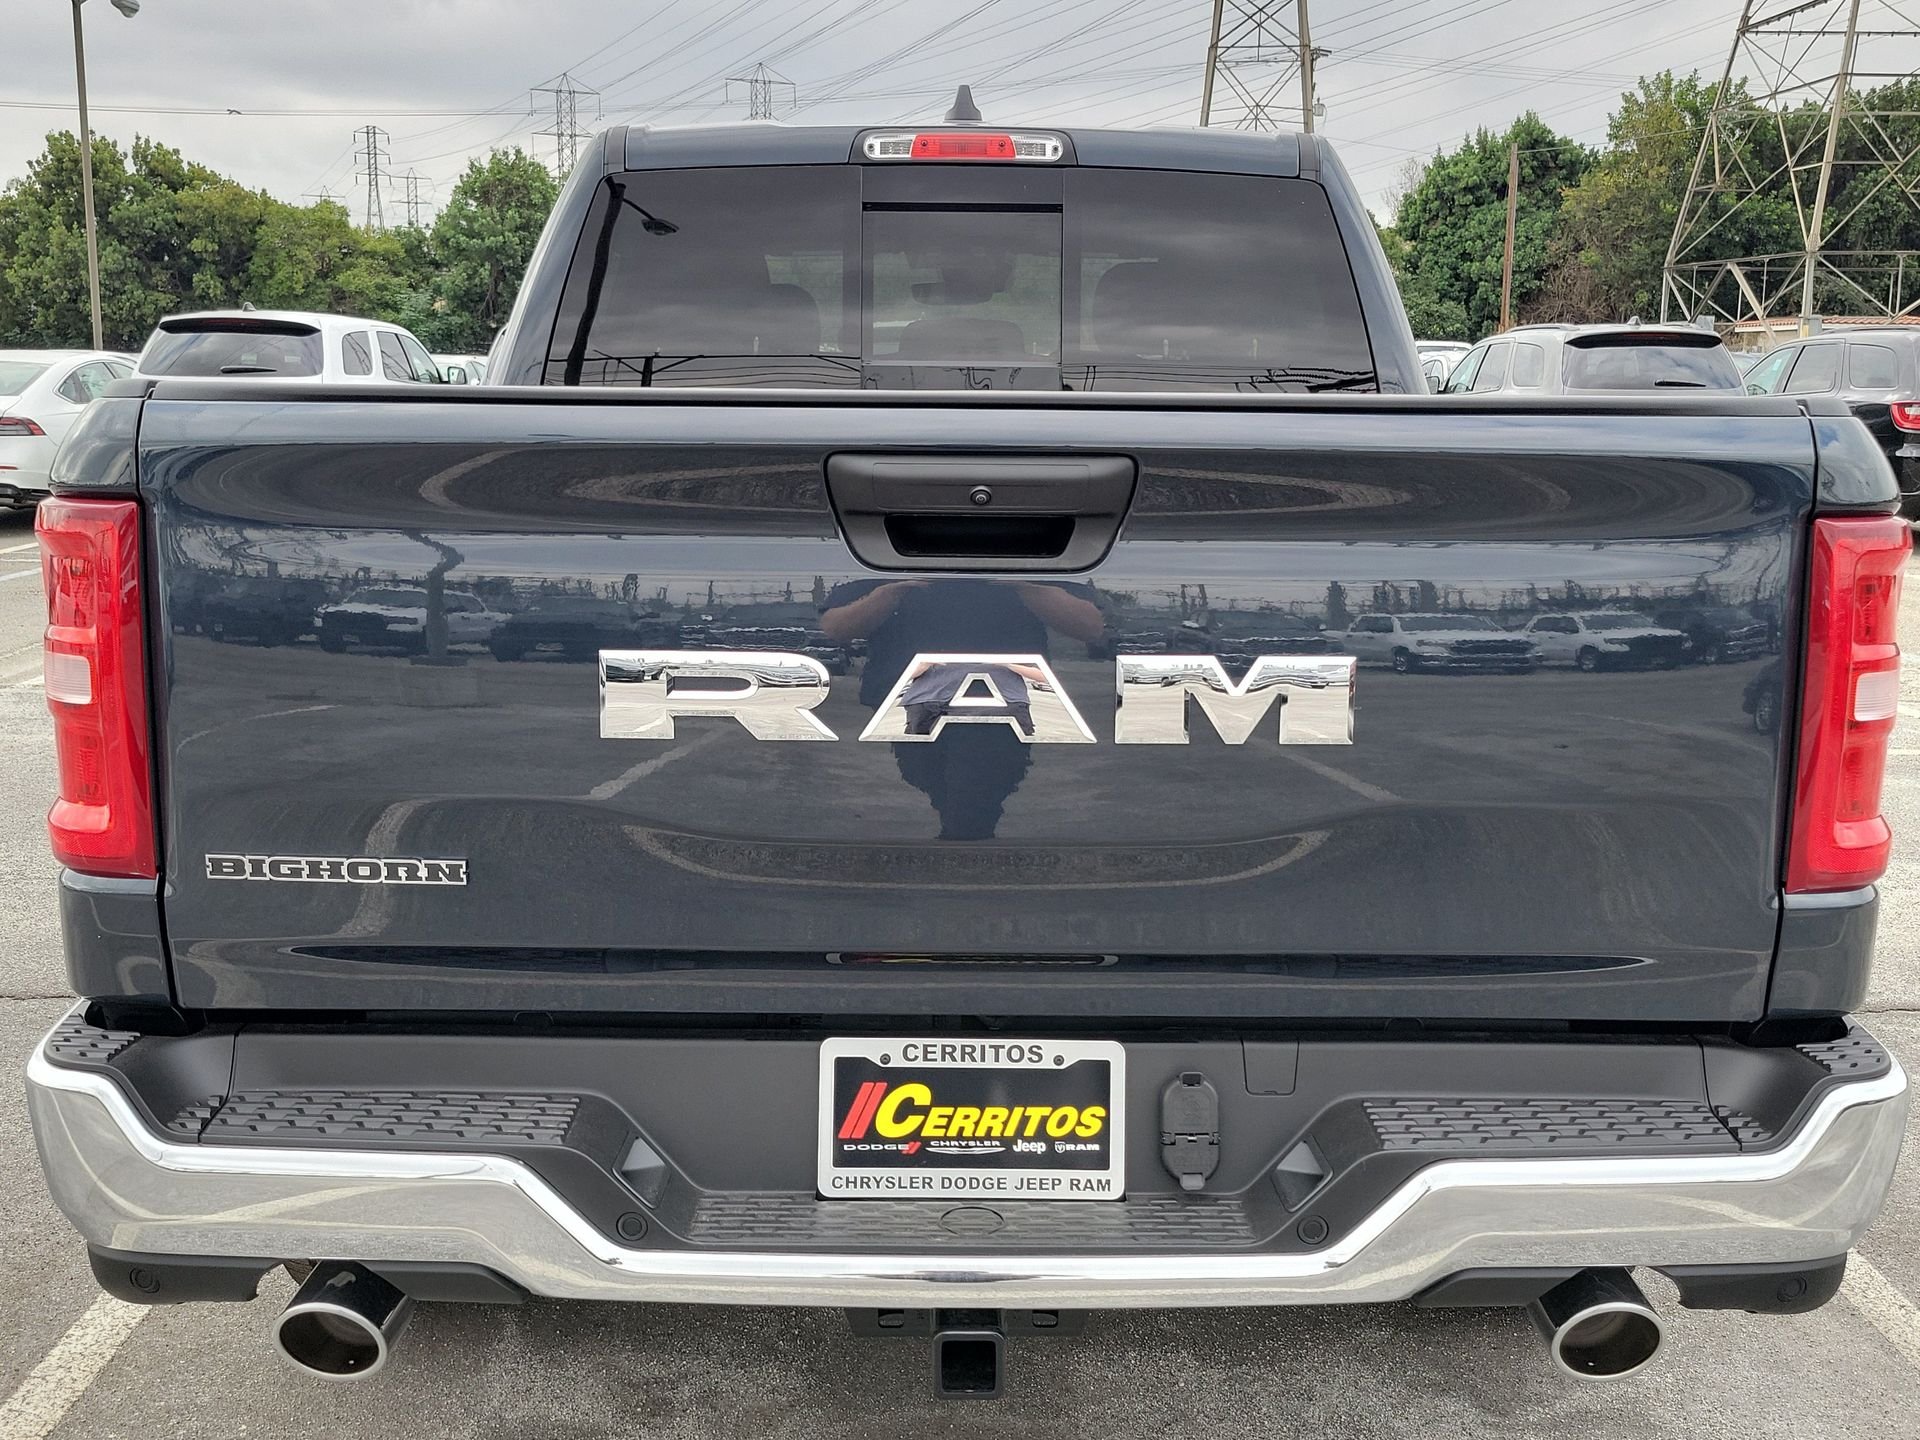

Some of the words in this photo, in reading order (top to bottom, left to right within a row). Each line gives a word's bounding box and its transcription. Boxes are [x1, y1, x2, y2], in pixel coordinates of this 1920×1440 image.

[598, 649, 1358, 746] RAM
[205, 854, 468, 885] BIGHORN
[902, 1043, 1044, 1064] CERRITOS
[875, 1083, 1106, 1138] CERRITOS
[1012, 1139, 1047, 1154] Jeep
[831, 1176, 934, 1190] CHRYSLER
[941, 1177, 1008, 1191] DODGE
[1014, 1177, 1062, 1191] JEEP
[1069, 1178, 1111, 1192] RAM
